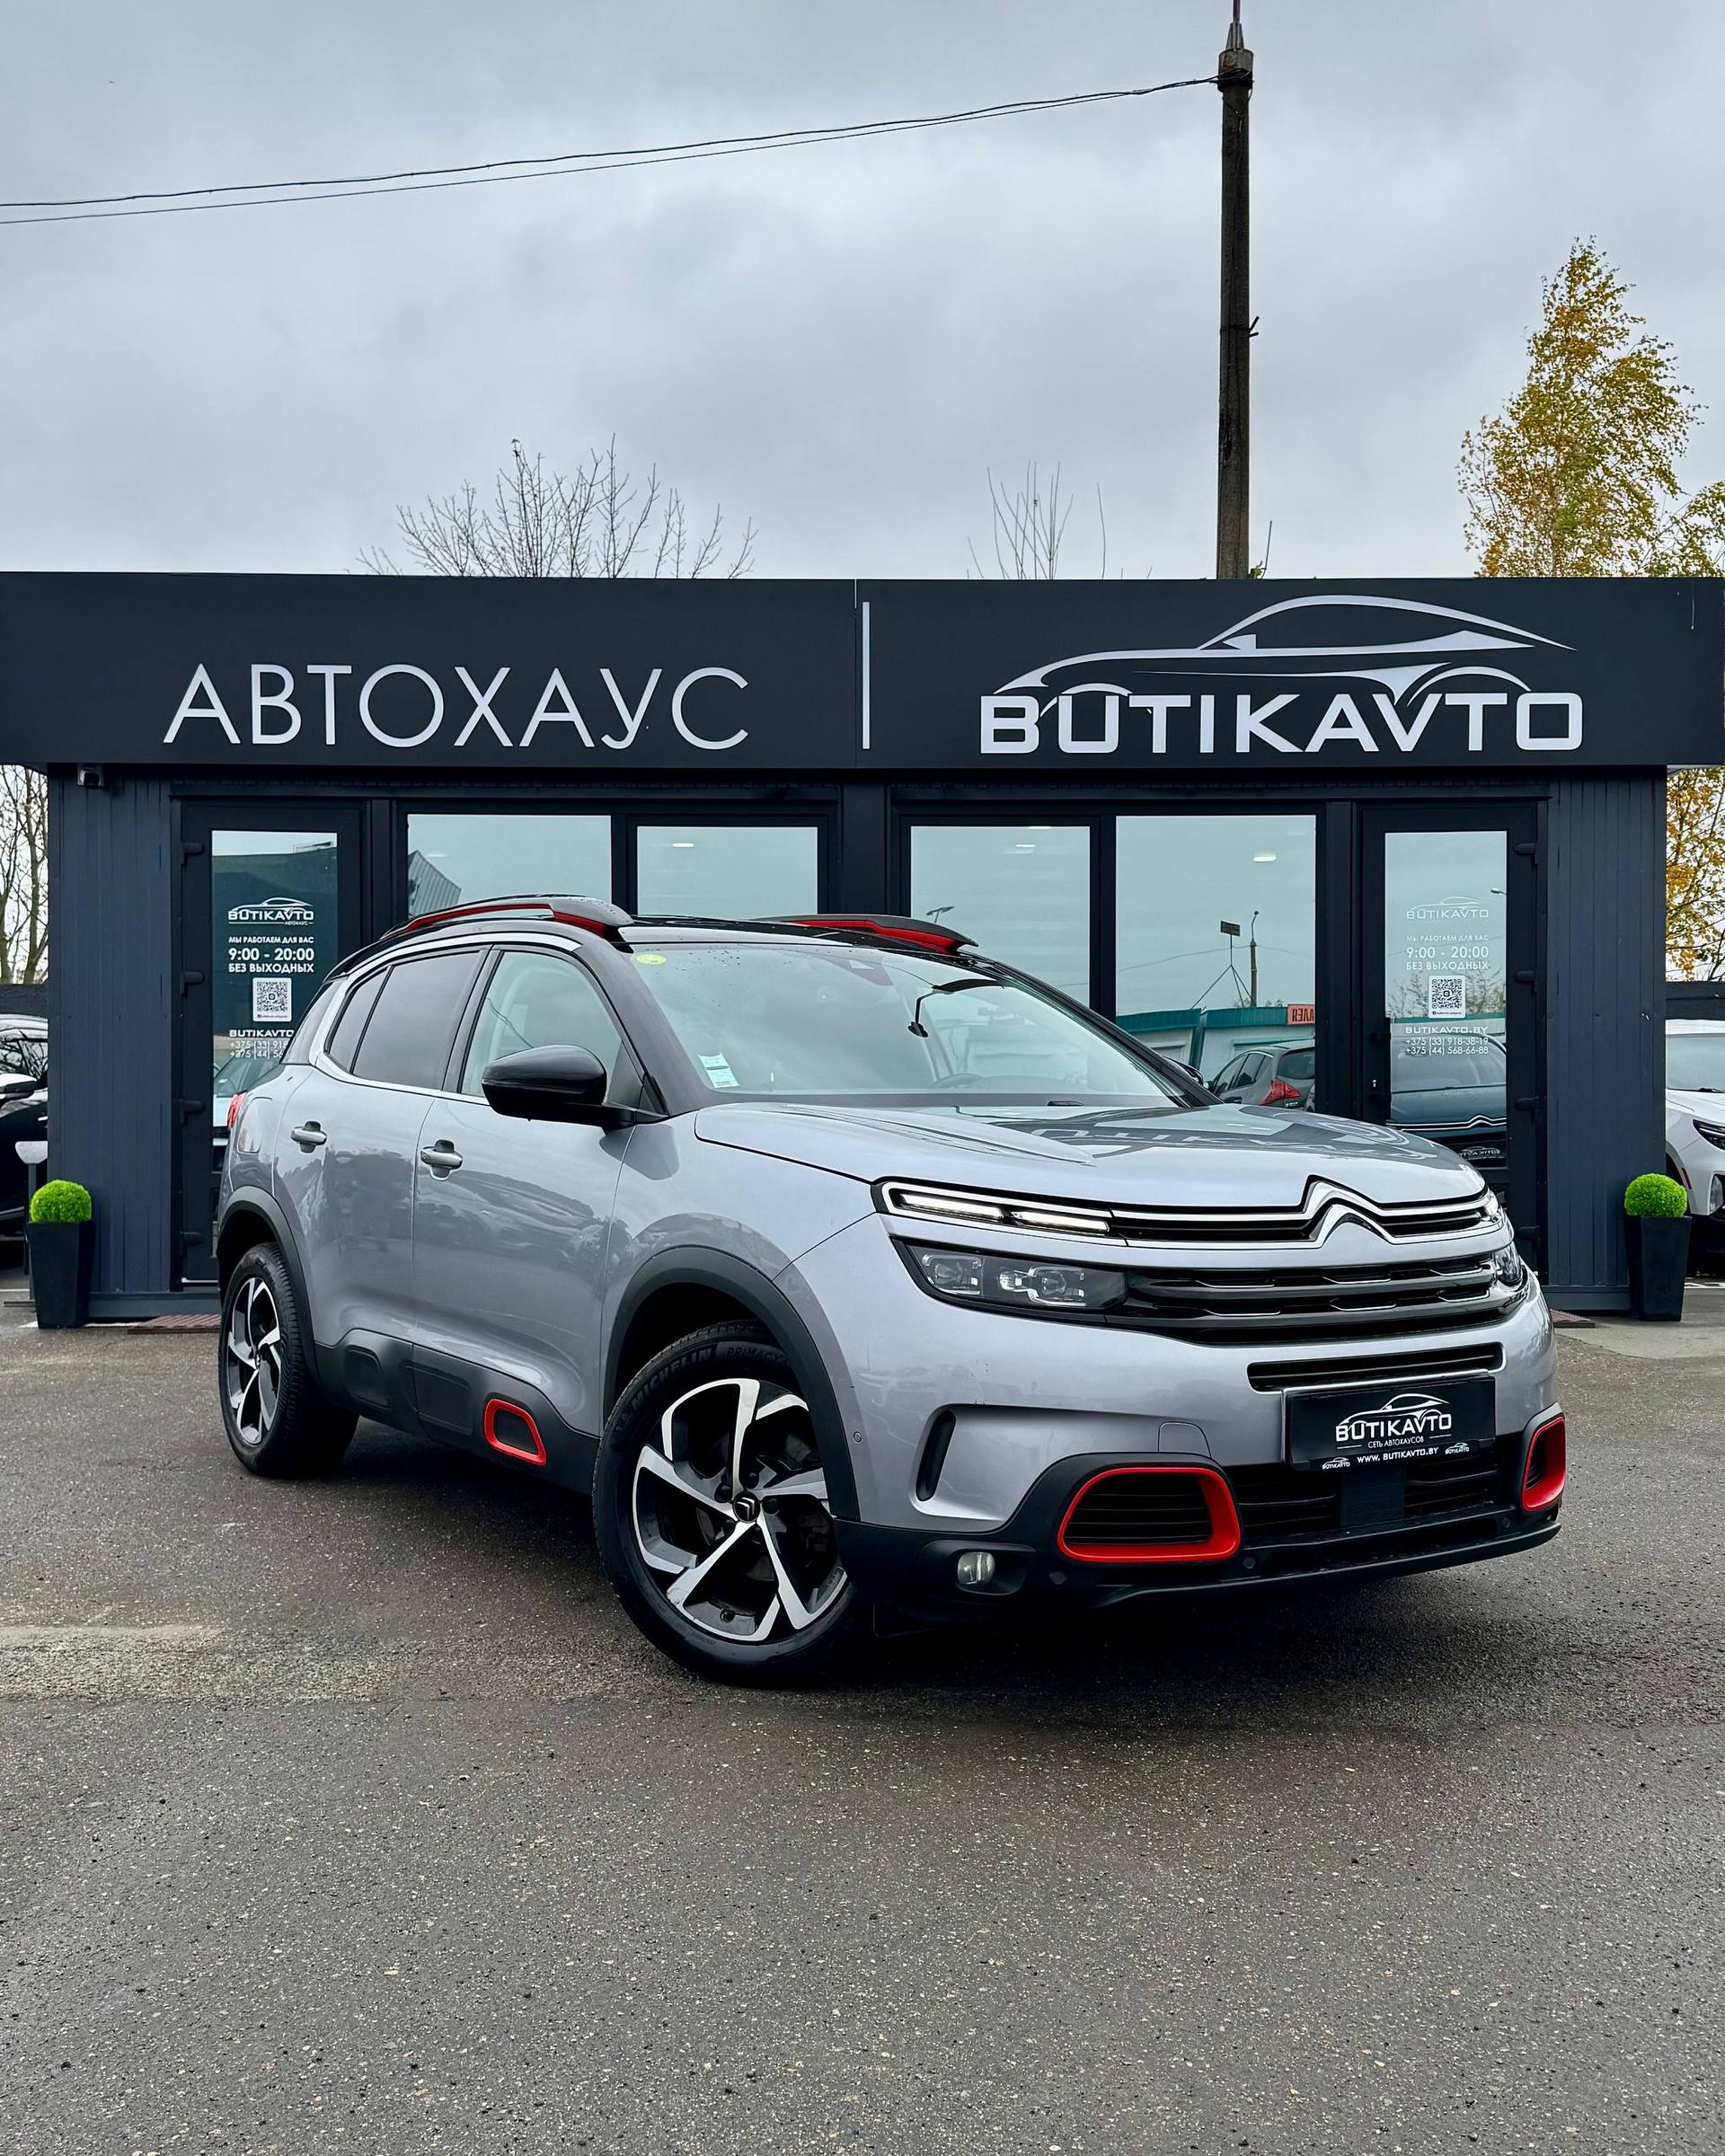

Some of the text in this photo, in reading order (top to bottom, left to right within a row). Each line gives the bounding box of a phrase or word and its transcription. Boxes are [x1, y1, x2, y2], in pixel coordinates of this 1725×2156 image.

[163, 662, 750, 750] АВТОХАУС
[980, 691, 1584, 755] BUTIKAVTO
[228, 910, 314, 921] BUTIKAVTO
[1406, 909, 1489, 920] BUTIKAVTO
[281, 936, 297, 944] ДЛЯ
[228, 948, 260, 961] 9:00
[274, 948, 314, 961] 20:00
[1406, 947, 1436, 959] 9:00
[1451, 946, 1489, 959] 20:00
[228, 963, 314, 974] БЕЗ ВЫХОДНЫХ
[1406, 961, 1489, 971] БЕЗ ВЫХОДНЫХ
[1405, 1026, 1489, 1034] BUTIKAVTO.BY
[229, 1040, 250, 1049] +375
[253, 1040, 270, 1050] (33)
[1405, 1037, 1489, 1047] +375 (33) 918-38-19
[253, 1050, 270, 1060] (44)
[1405, 1046, 1489, 1056] +375 (44) 568-66-88
[632, 1348, 712, 1409] MICHELIN
[1335, 1413, 1452, 1442] BUTIKAVTO
[1367, 1436, 1424, 1449] СЕТЬ АВТОХАУСОВ
[1357, 1446, 1438, 1463] WWW. BUTIKAVTO.BY
